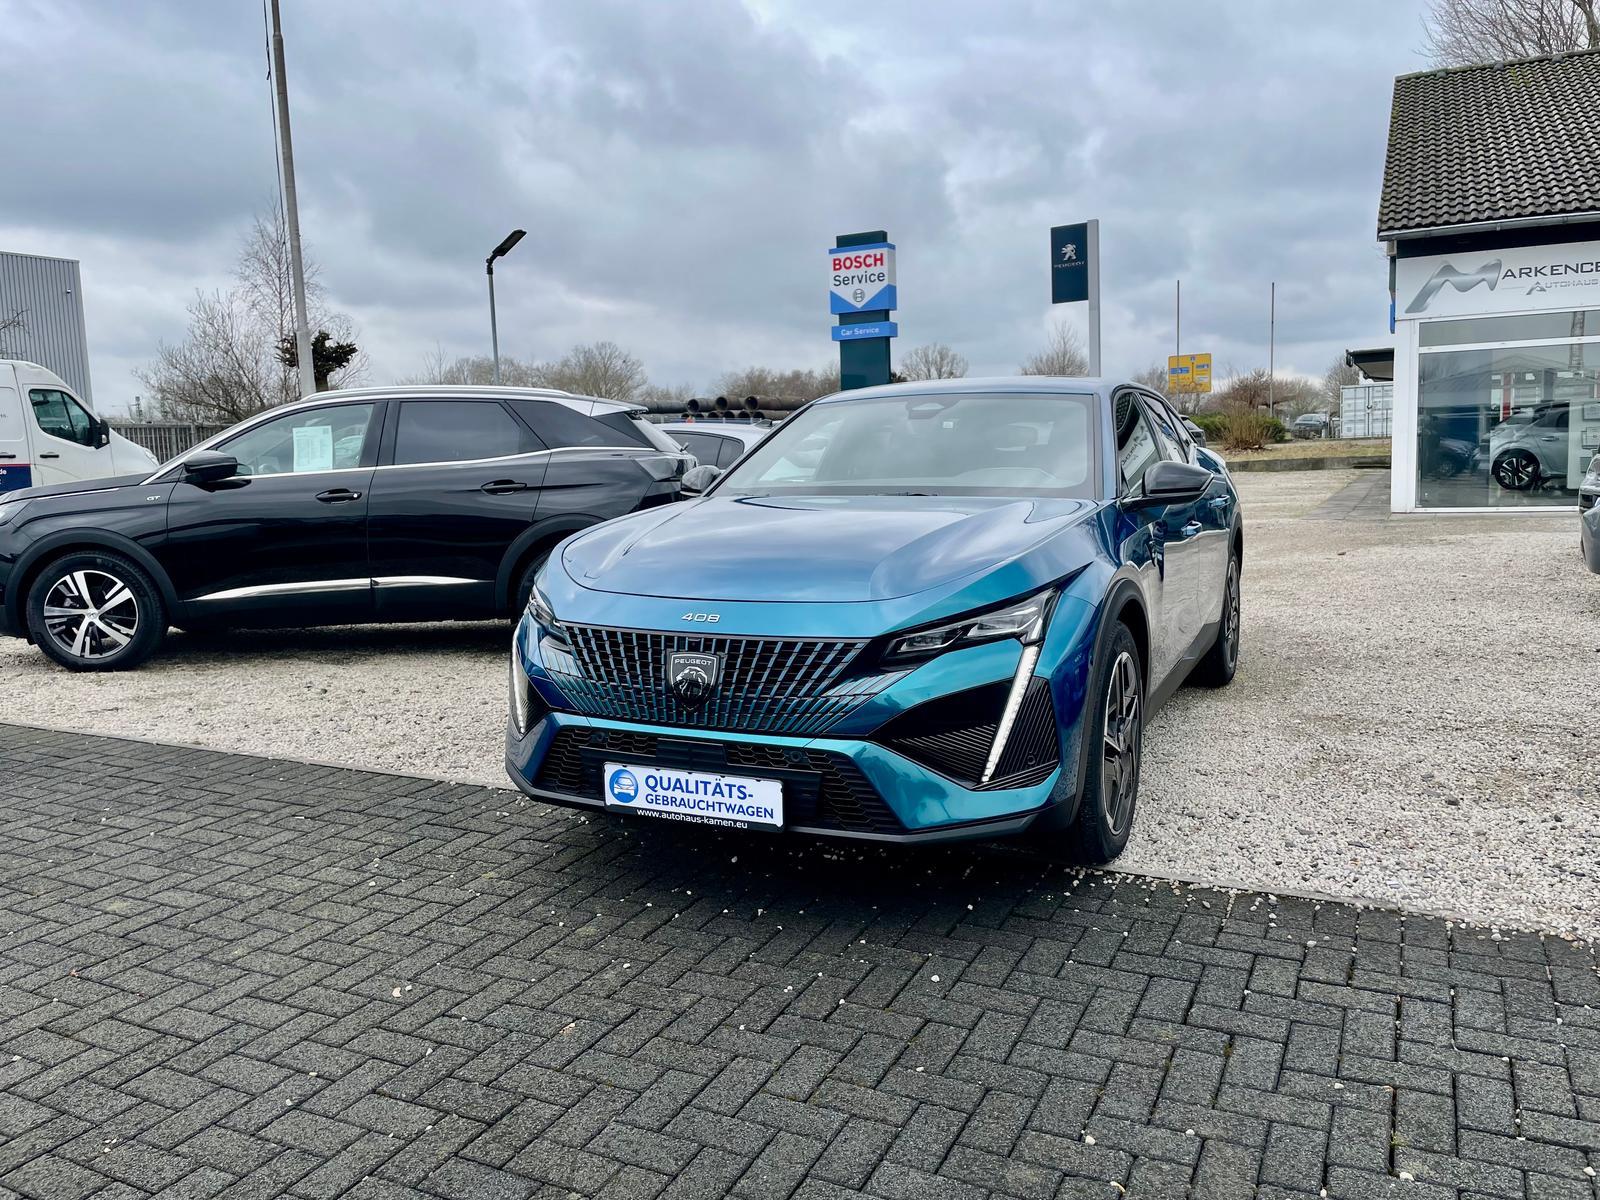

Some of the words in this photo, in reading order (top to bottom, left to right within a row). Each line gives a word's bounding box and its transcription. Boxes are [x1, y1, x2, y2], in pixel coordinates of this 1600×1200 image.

[832, 253, 884, 271] BOSCH
[833, 270, 886, 287] Service
[1526, 278, 1599, 296] AUTOHAUS
[840, 328, 853, 336] Car
[854, 326, 880, 335] Service
[681, 612, 720, 623] 408
[674, 658, 712, 666] PEUGEOT
[644, 774, 754, 800] QUALITÄTS-
[645, 793, 774, 819] GEBRAUCHTWAGEN
[636, 808, 748, 829] www.autohaus-kamen.eu
